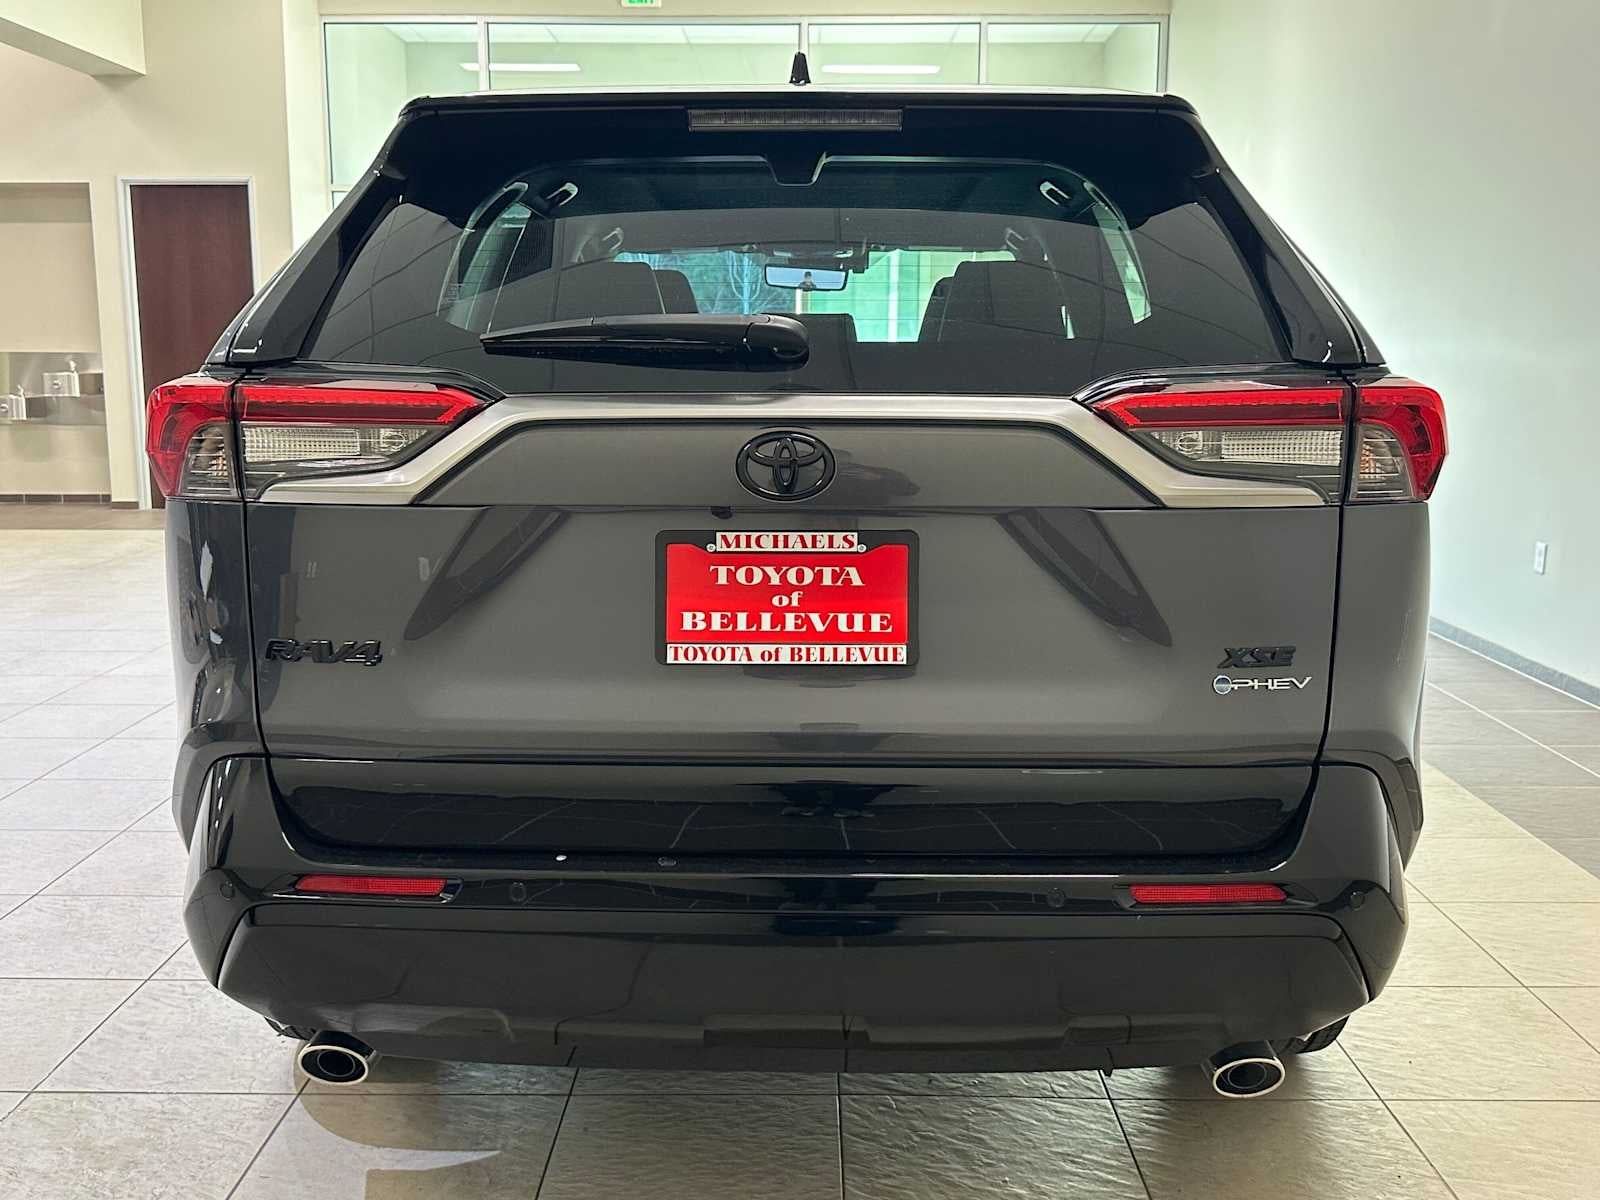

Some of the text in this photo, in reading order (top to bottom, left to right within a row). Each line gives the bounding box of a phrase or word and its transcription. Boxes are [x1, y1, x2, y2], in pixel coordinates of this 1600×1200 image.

[719, 534, 856, 549] MICHAELS
[709, 565, 866, 586] TOYOTA
[771, 591, 804, 607] of
[680, 611, 893, 633] BELLEVUE
[265, 639, 383, 666] RAV4
[669, 646, 905, 662] TOYOTA of BELLEVUE
[1217, 647, 1296, 668] XSE
[1231, 676, 1312, 690] PHEV
